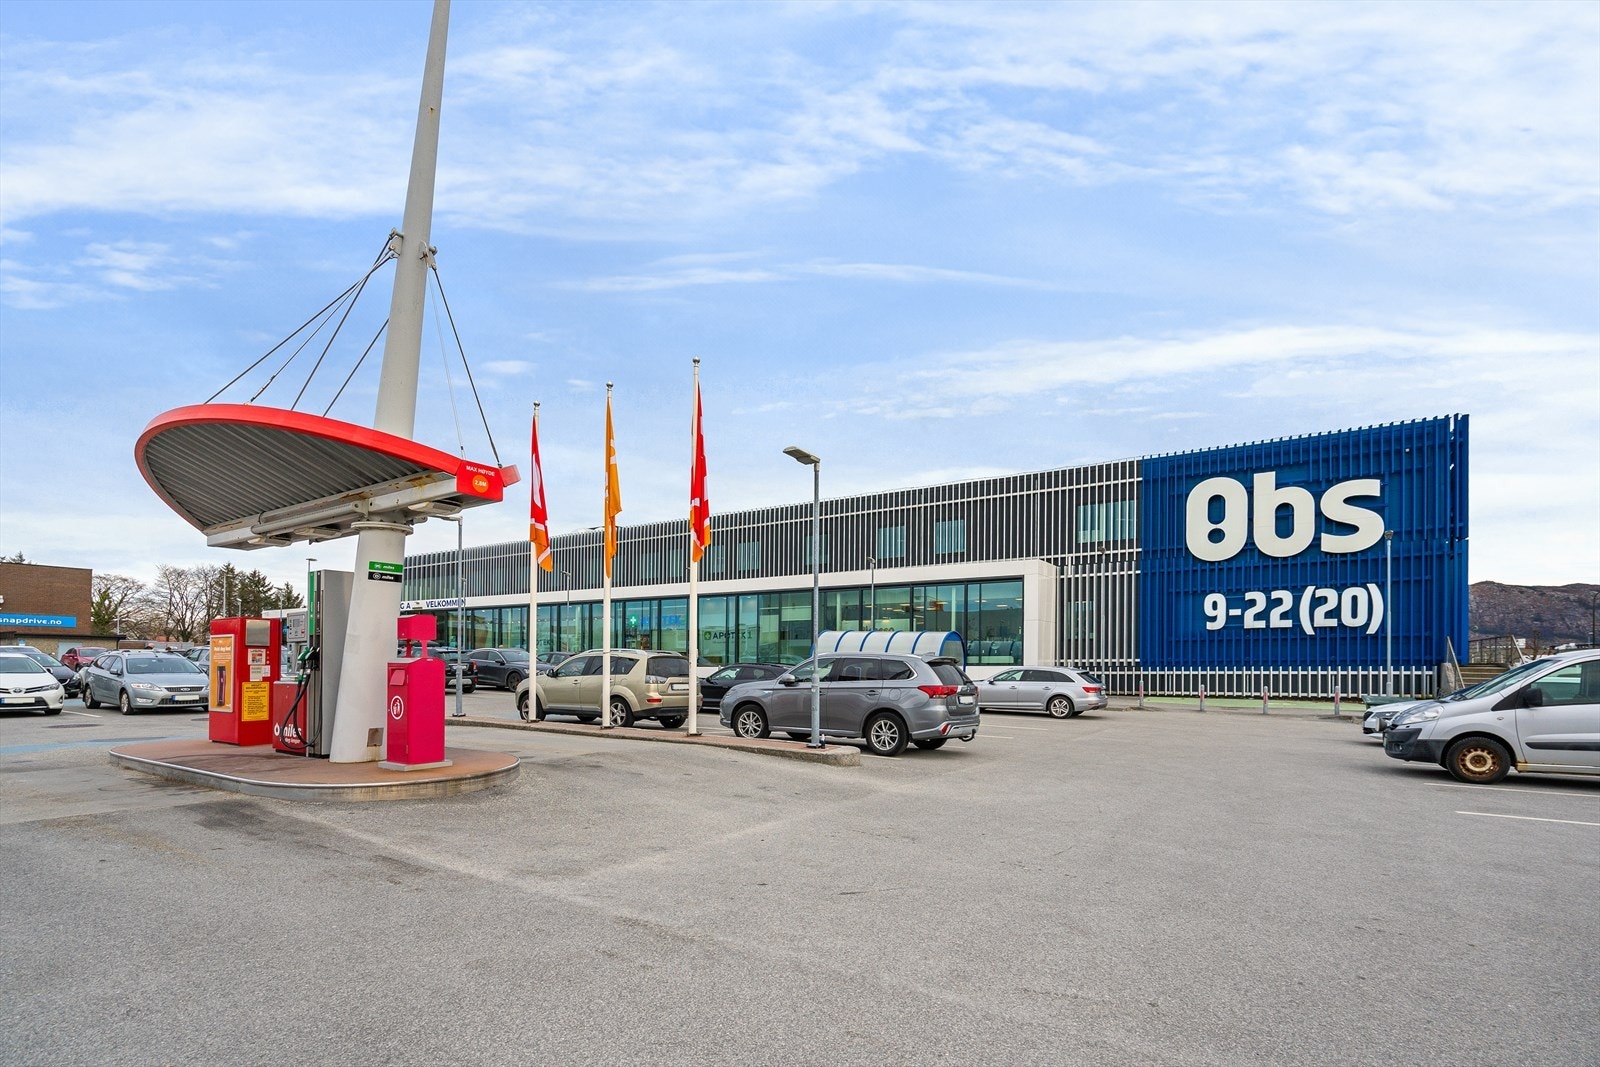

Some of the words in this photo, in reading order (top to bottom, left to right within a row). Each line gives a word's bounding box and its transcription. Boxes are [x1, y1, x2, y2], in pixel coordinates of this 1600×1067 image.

[477, 468, 495, 477] HØYDE
[1203, 583, 1384, 635] 9-22(20)
[712, 631, 746, 639] APOTK
